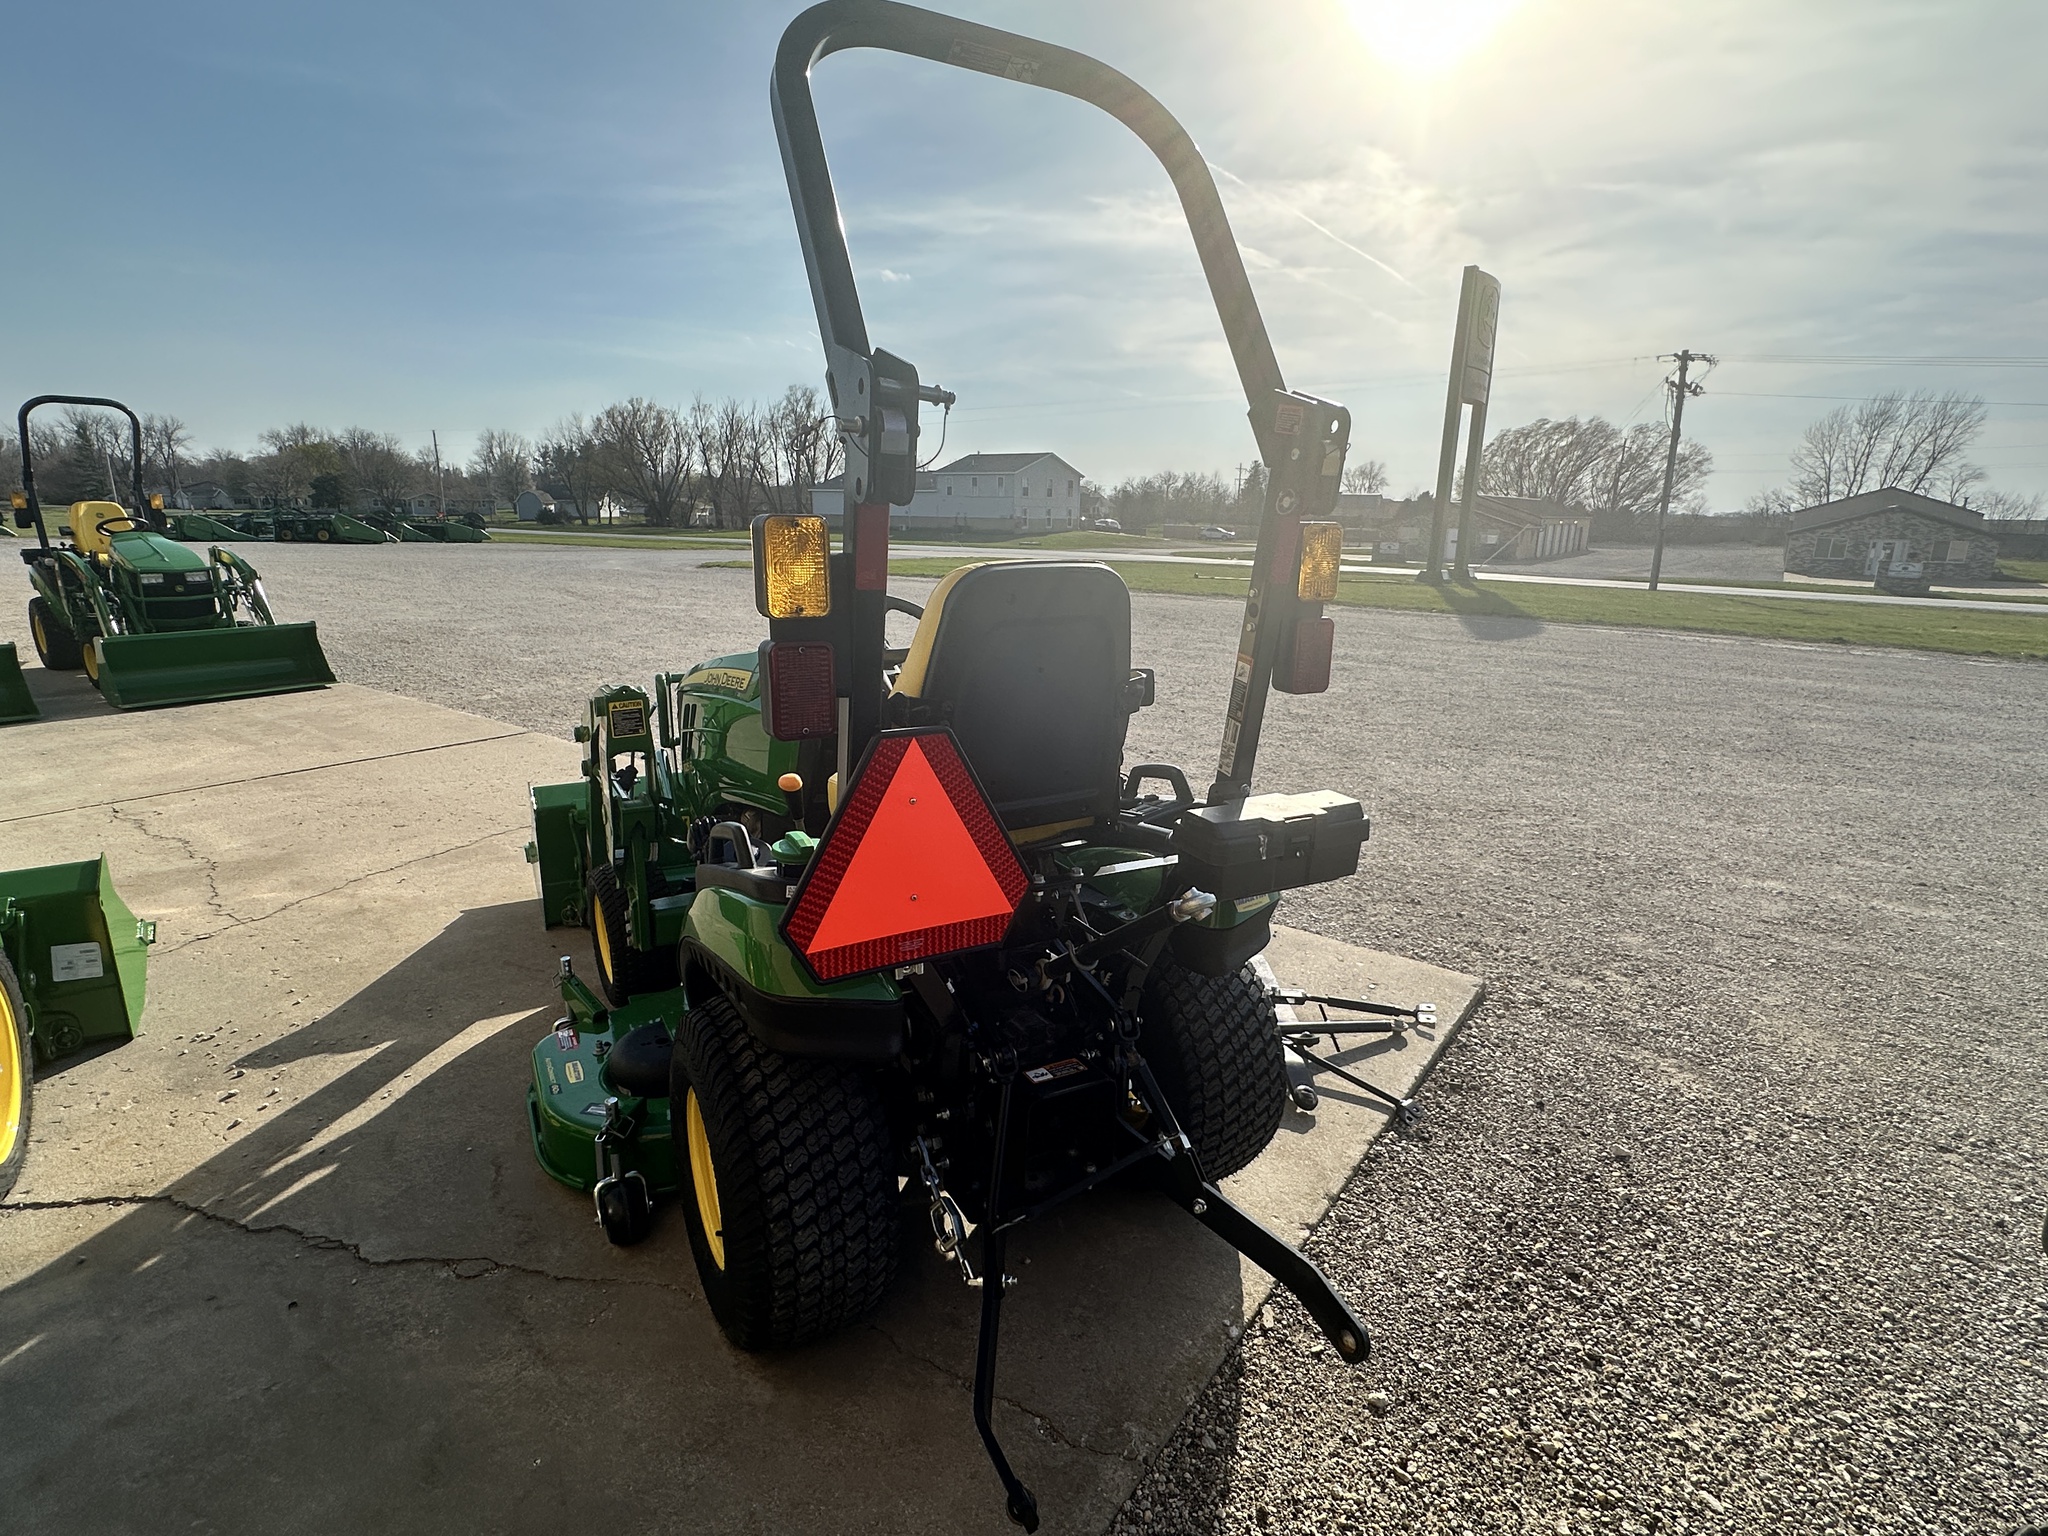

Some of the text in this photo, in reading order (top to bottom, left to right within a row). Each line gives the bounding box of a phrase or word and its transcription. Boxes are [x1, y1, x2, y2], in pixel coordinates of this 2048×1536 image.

[704, 671, 746, 689] JOHN DEERE
[619, 701, 642, 709] CAUTION
